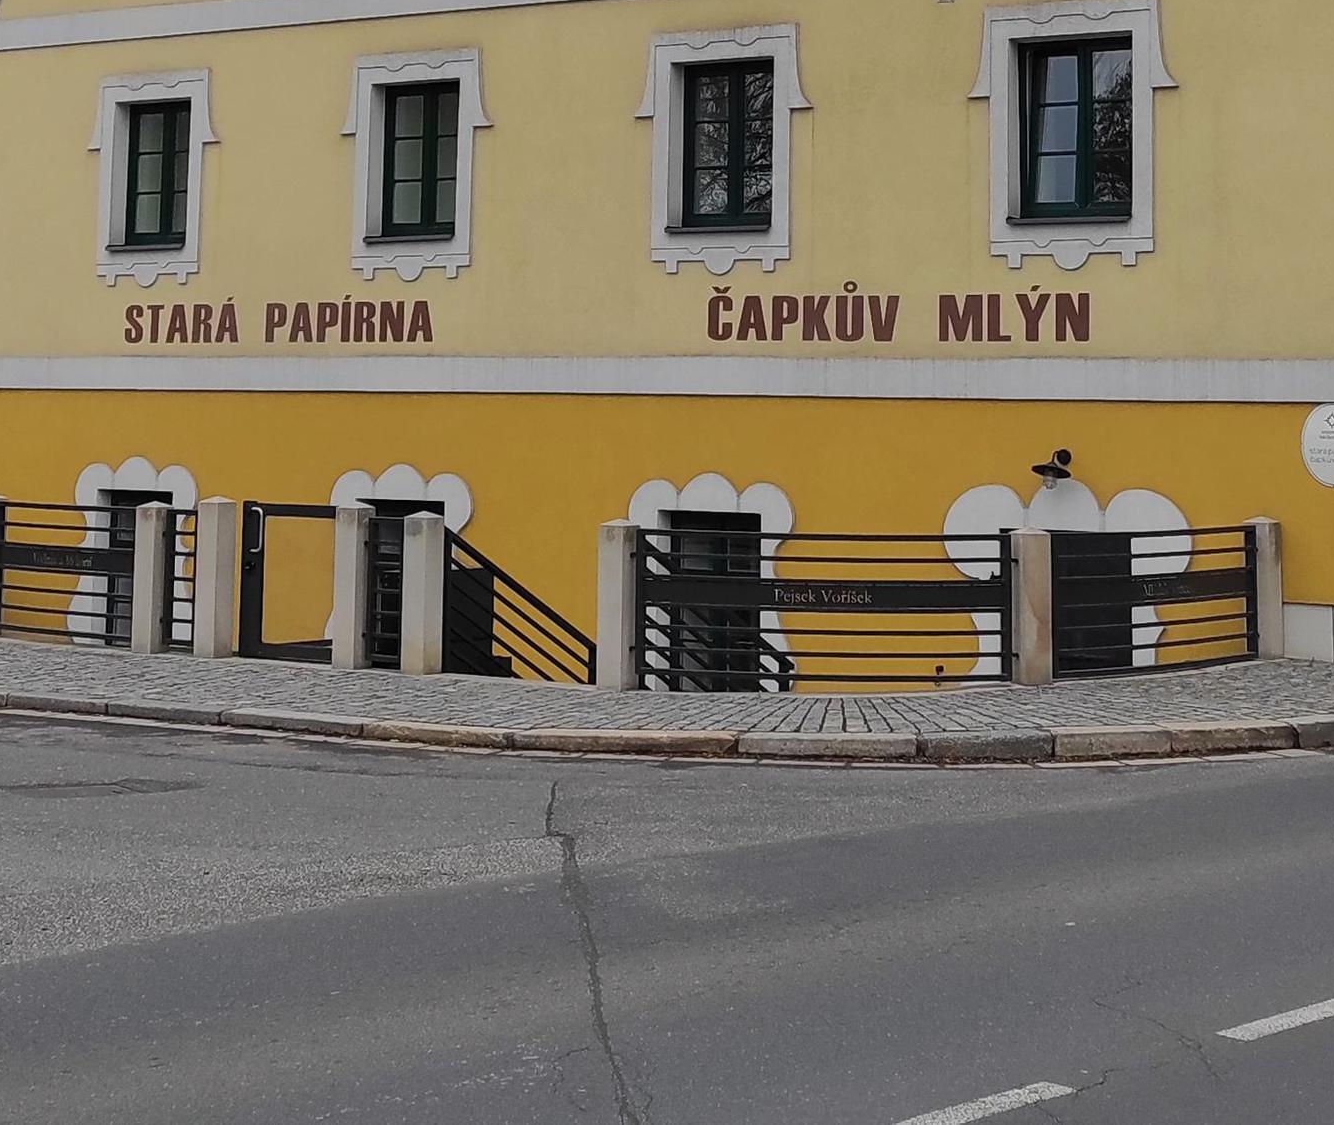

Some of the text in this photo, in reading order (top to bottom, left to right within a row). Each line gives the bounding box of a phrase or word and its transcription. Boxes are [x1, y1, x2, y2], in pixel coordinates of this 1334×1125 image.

[123, 293, 434, 344] STARÁ PAPÍRNA
[706, 280, 1091, 342] ČAPKŮV MLÝN
[773, 588, 817, 605] Pejsek
